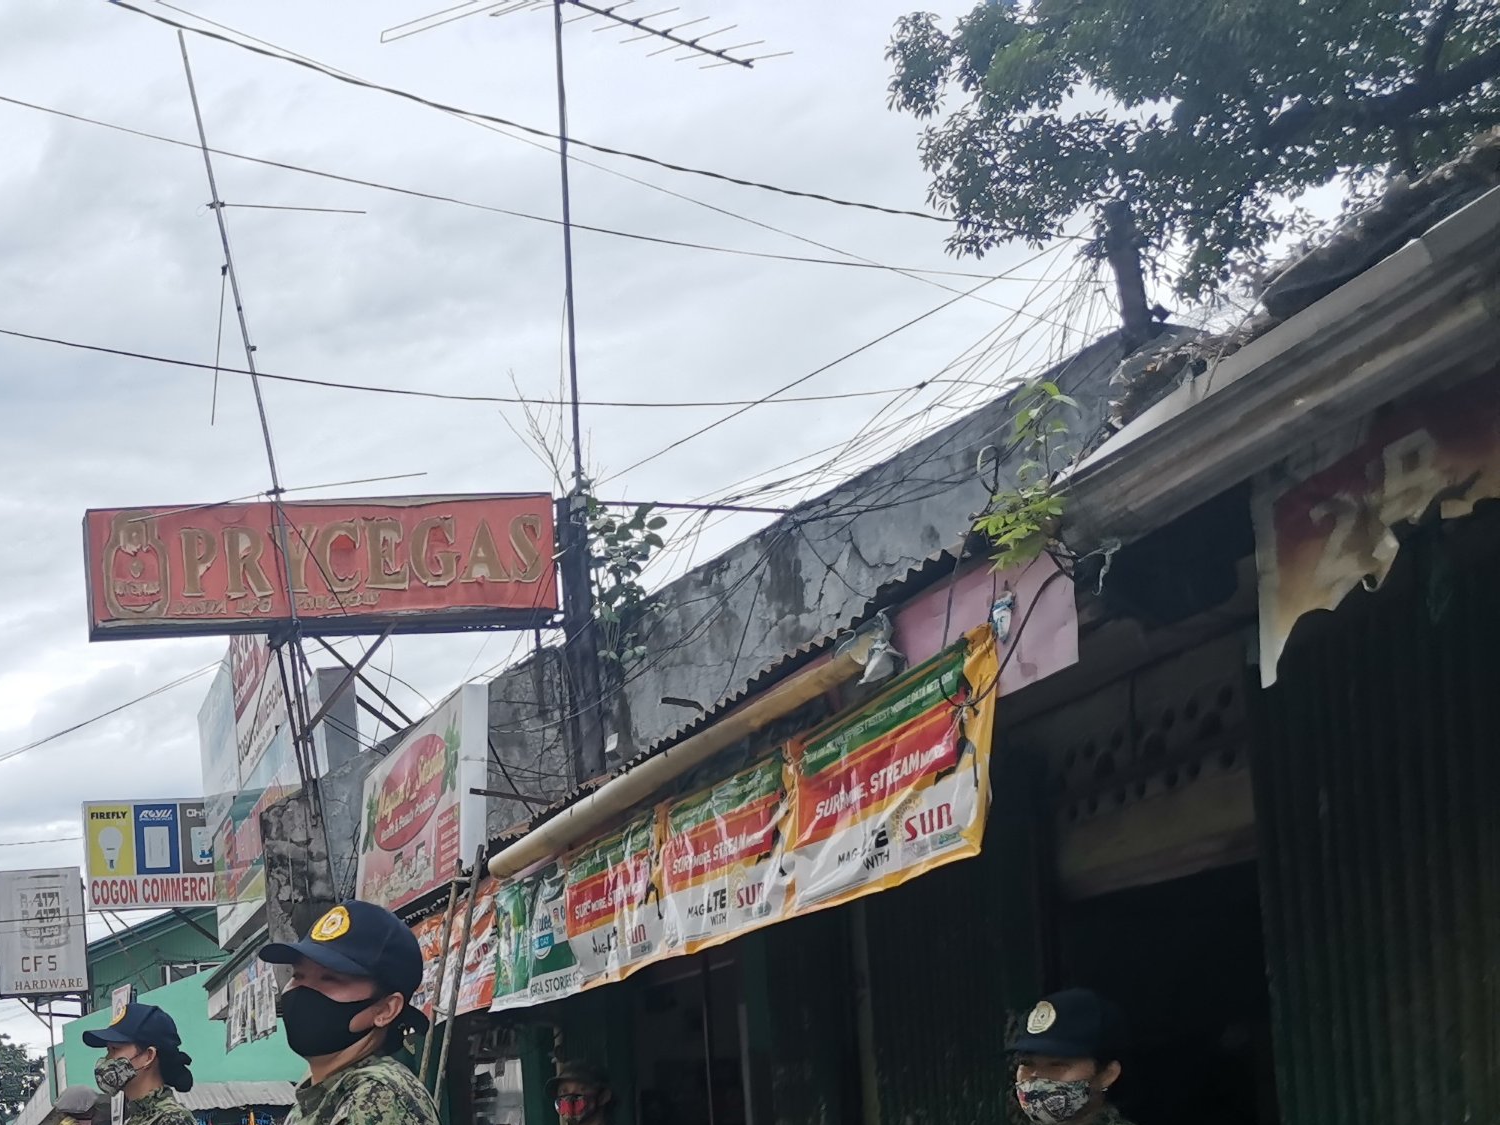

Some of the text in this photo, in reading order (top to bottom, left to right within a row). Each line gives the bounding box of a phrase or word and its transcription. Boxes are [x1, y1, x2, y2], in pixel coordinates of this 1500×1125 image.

[179, 513, 544, 601] PRYCEGAS
[869, 751, 920, 794] STREAM
[90, 811, 127, 820] FIREFLY
[863, 850, 890, 870] WITH
[91, 879, 138, 905] COGON
[710, 912, 727, 927] WITH
[21, 955, 57, 972] CFS
[15, 978, 83, 991] HARDWARE
